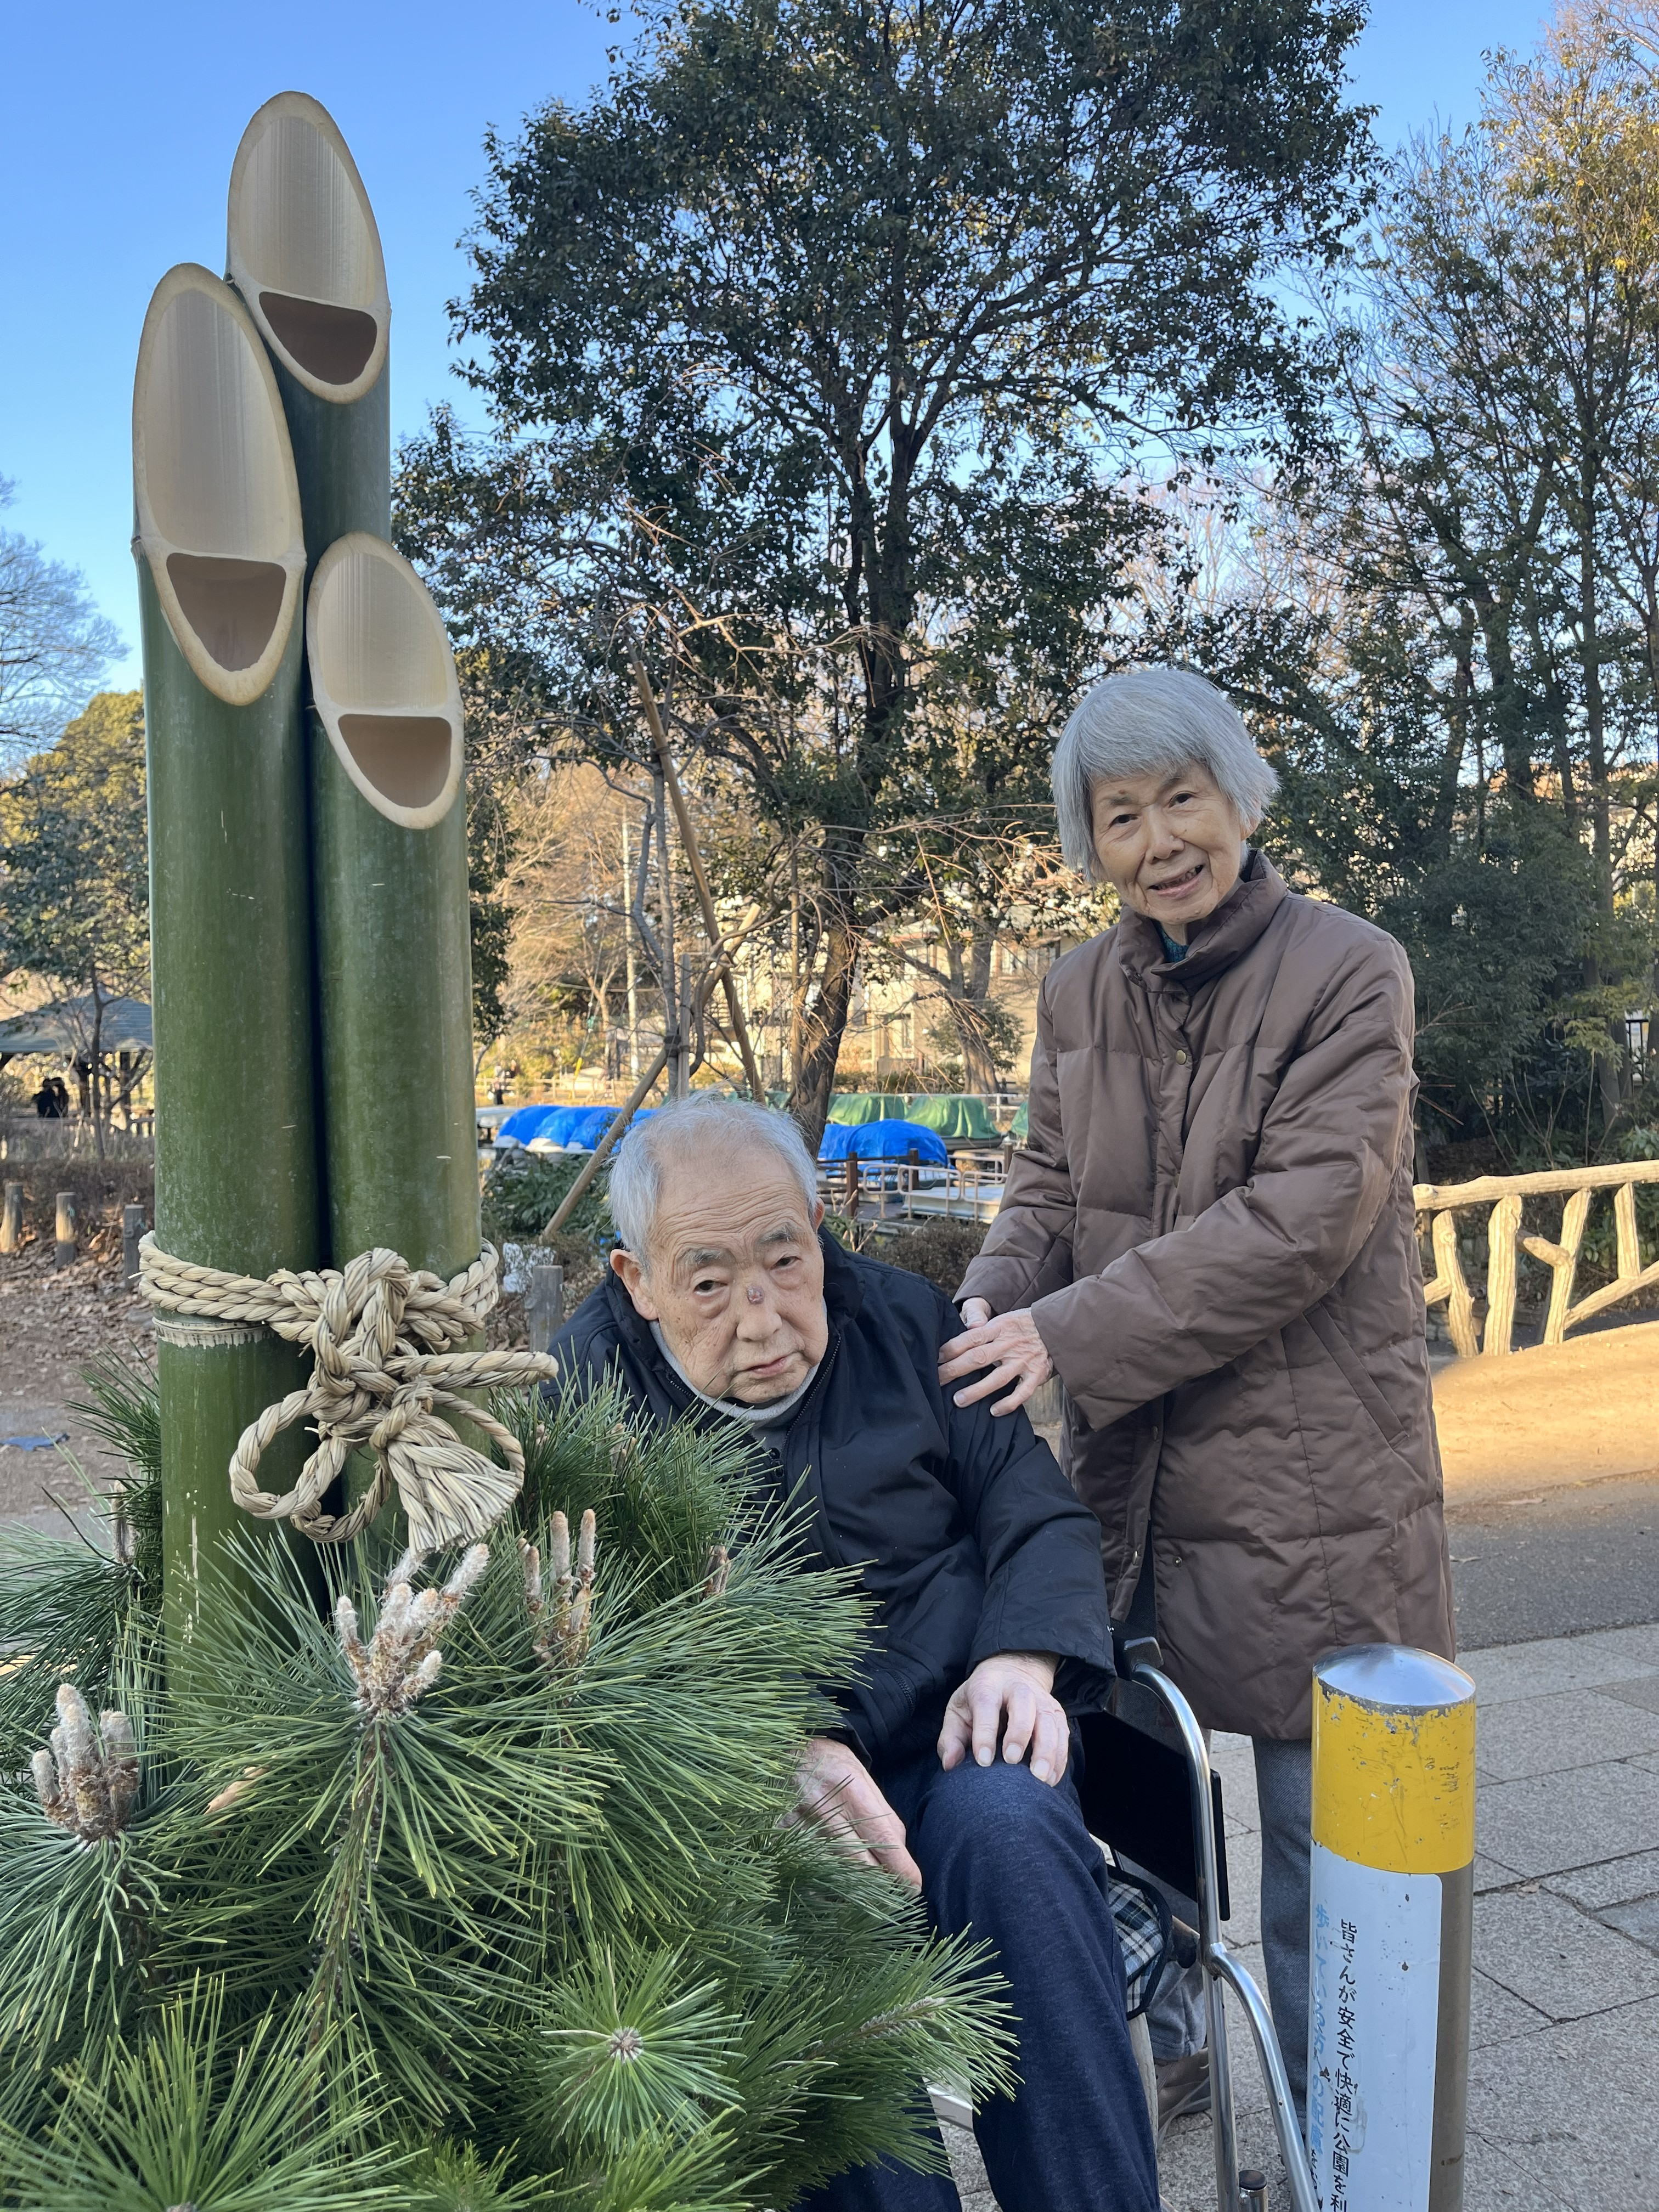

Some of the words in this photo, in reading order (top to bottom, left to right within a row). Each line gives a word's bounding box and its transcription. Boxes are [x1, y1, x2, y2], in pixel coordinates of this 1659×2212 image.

[1330, 1918, 1357, 2212] 皆さんが安全で快適に公園を利
